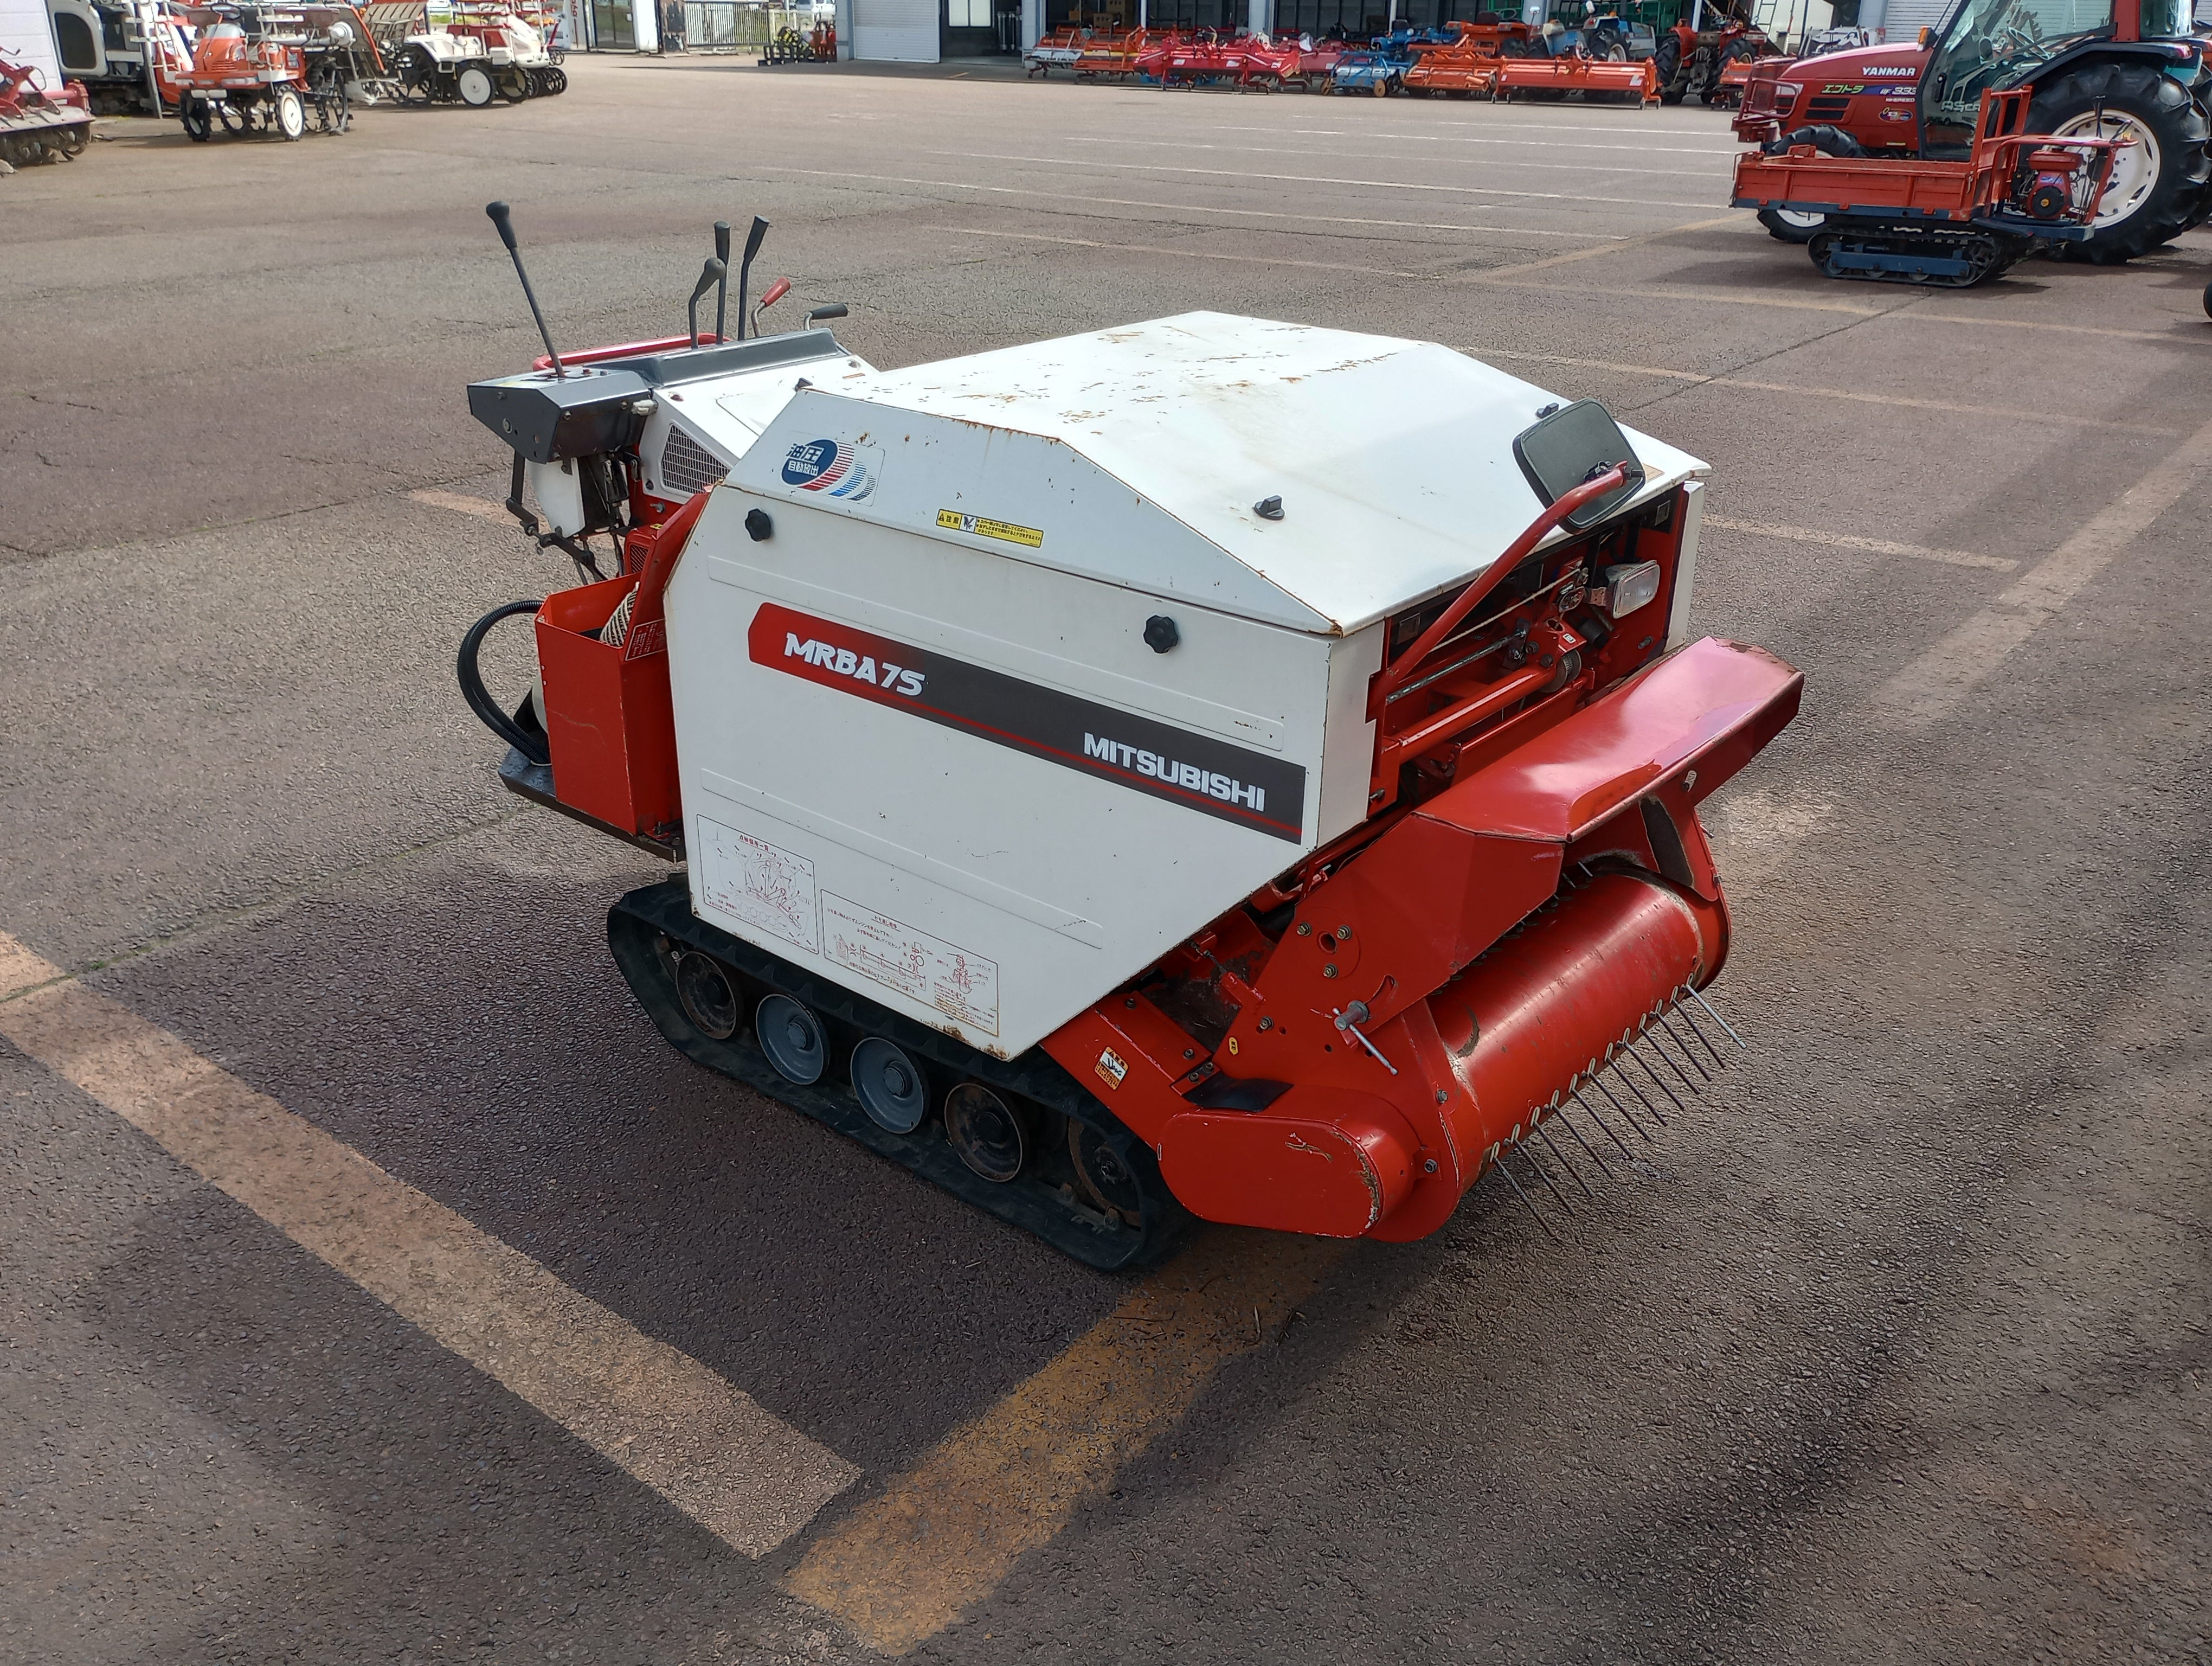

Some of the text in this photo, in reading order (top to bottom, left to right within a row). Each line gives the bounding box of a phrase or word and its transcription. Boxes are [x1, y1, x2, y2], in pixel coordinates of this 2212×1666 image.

[1862, 67, 1915, 76] YANMAR
[1822, 85, 1864, 94] エコトラ
[786, 443, 825, 464] 油圧
[788, 460, 820, 477] 自動放出
[784, 632, 925, 696] MRBA7S
[1084, 732, 1265, 812] MITSUBISHI
